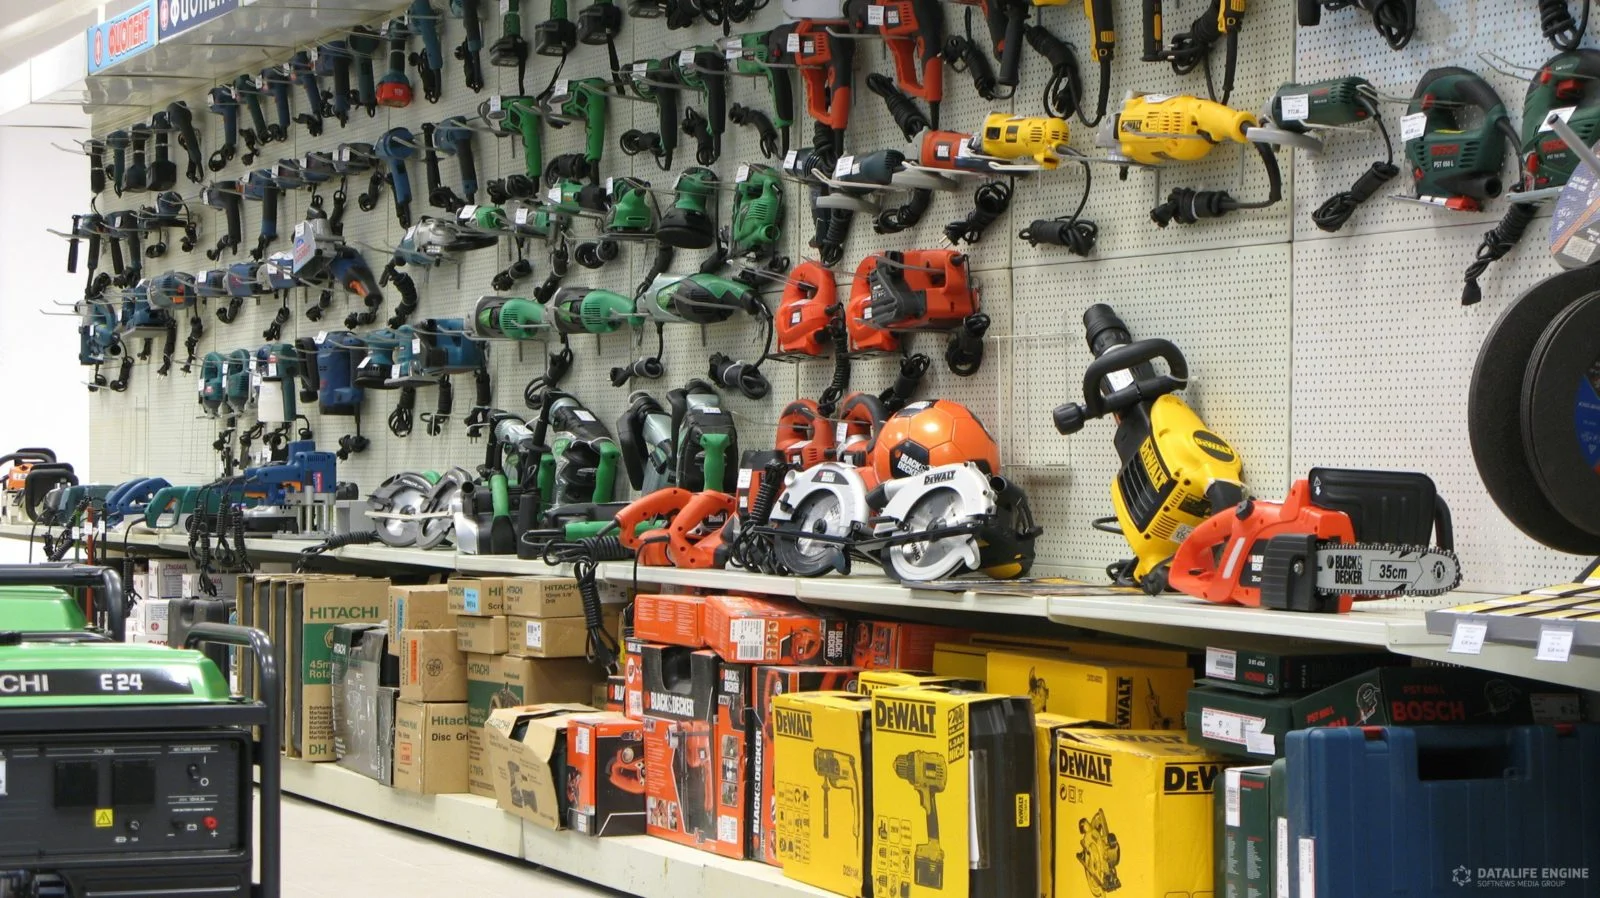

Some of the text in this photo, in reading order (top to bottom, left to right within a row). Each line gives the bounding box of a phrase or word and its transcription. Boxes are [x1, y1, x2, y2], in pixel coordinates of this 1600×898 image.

[1335, 570, 1362, 585] DECKER
[1379, 564, 1407, 579] 35cm
[310, 606, 378, 618] HITACHI
[1391, 700, 1465, 722] BOSCH
[432, 733, 451, 741] Disc
[309, 744, 327, 755] DH
